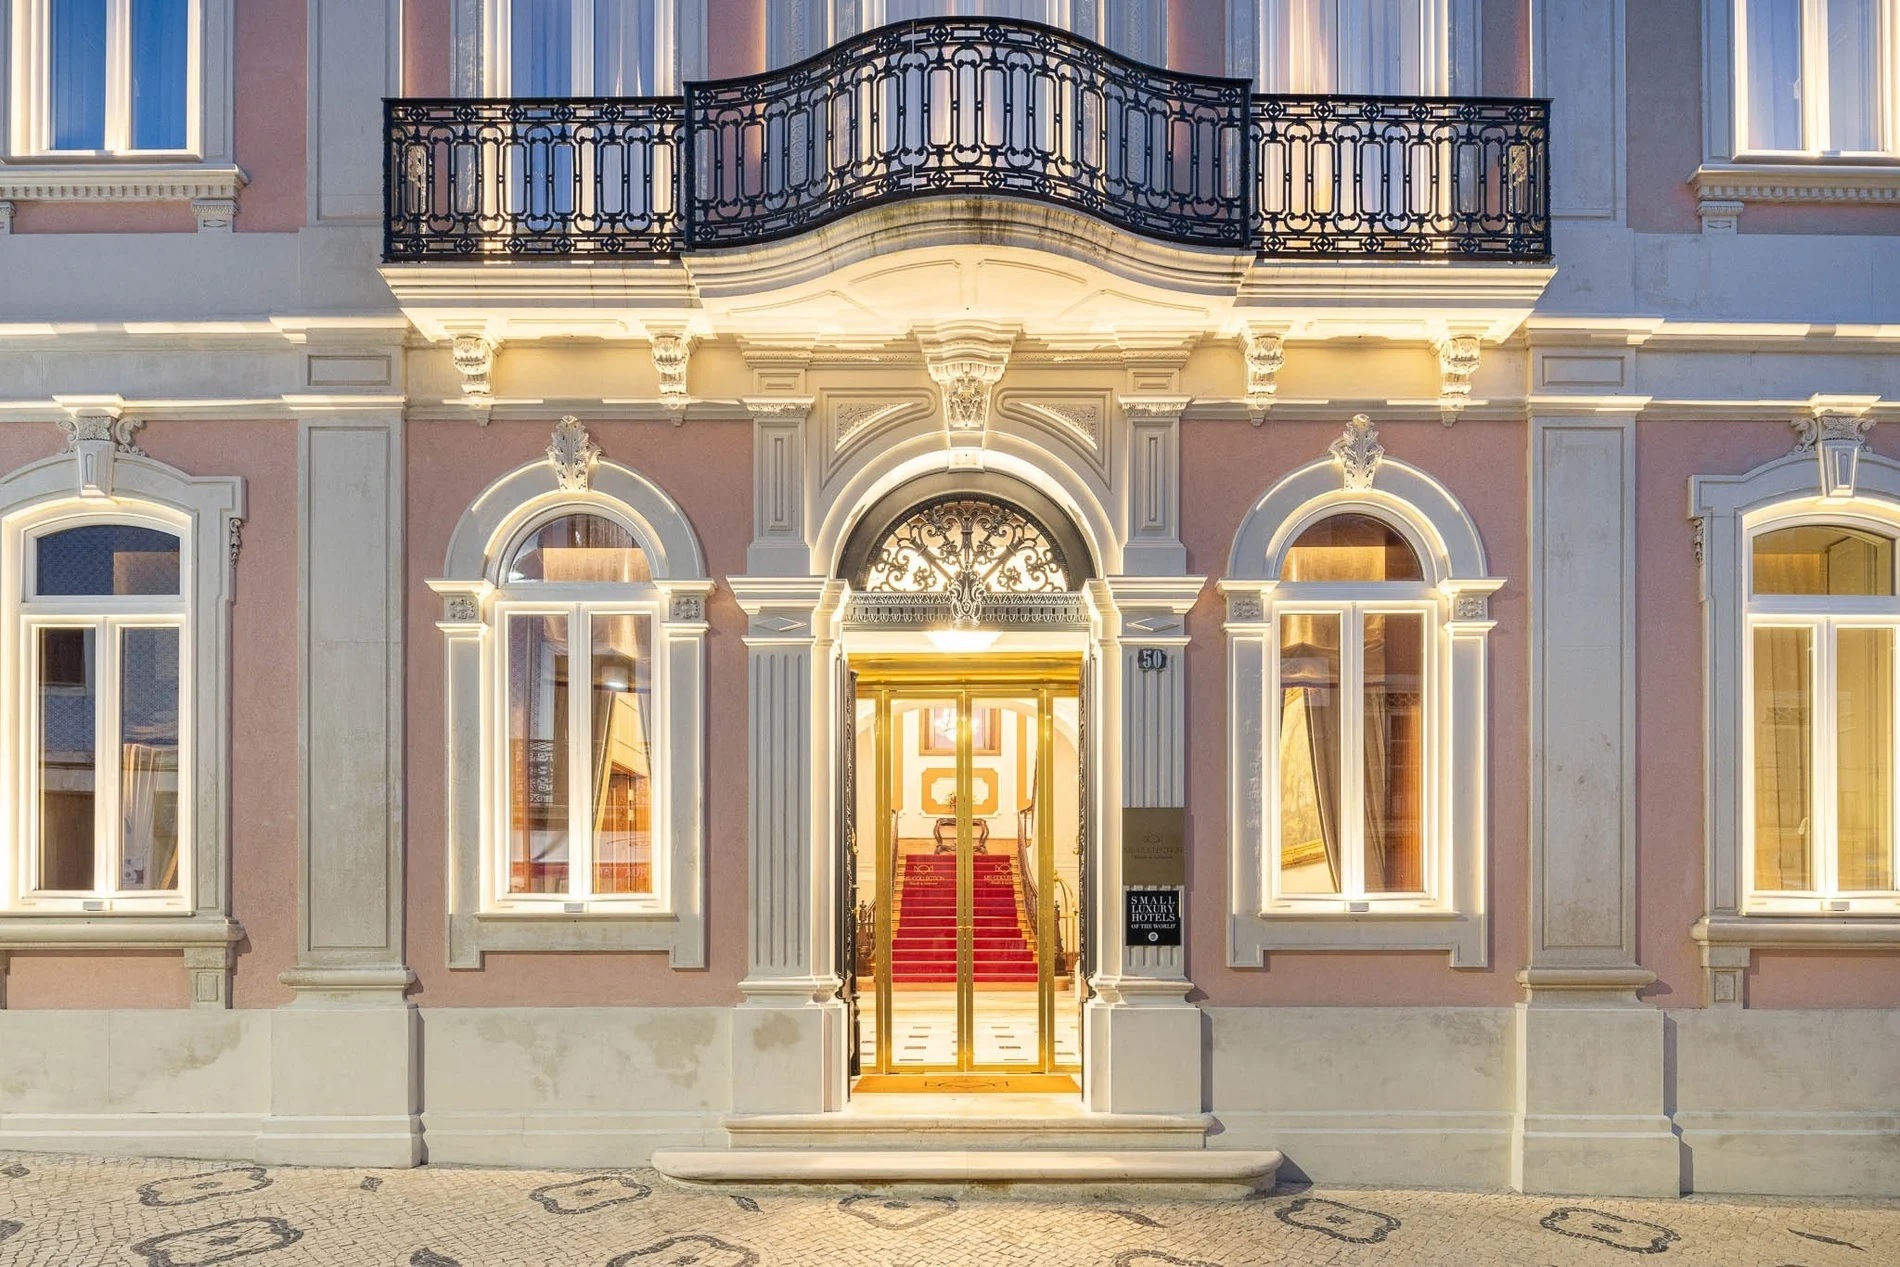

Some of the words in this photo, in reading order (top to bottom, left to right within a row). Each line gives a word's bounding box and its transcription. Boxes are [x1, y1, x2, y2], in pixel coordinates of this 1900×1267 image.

[1142, 649, 1163, 668] 50
[1130, 896, 1176, 905] SMALL
[1131, 904, 1175, 913] LUXURY
[1131, 913, 1176, 922] HOTELS
